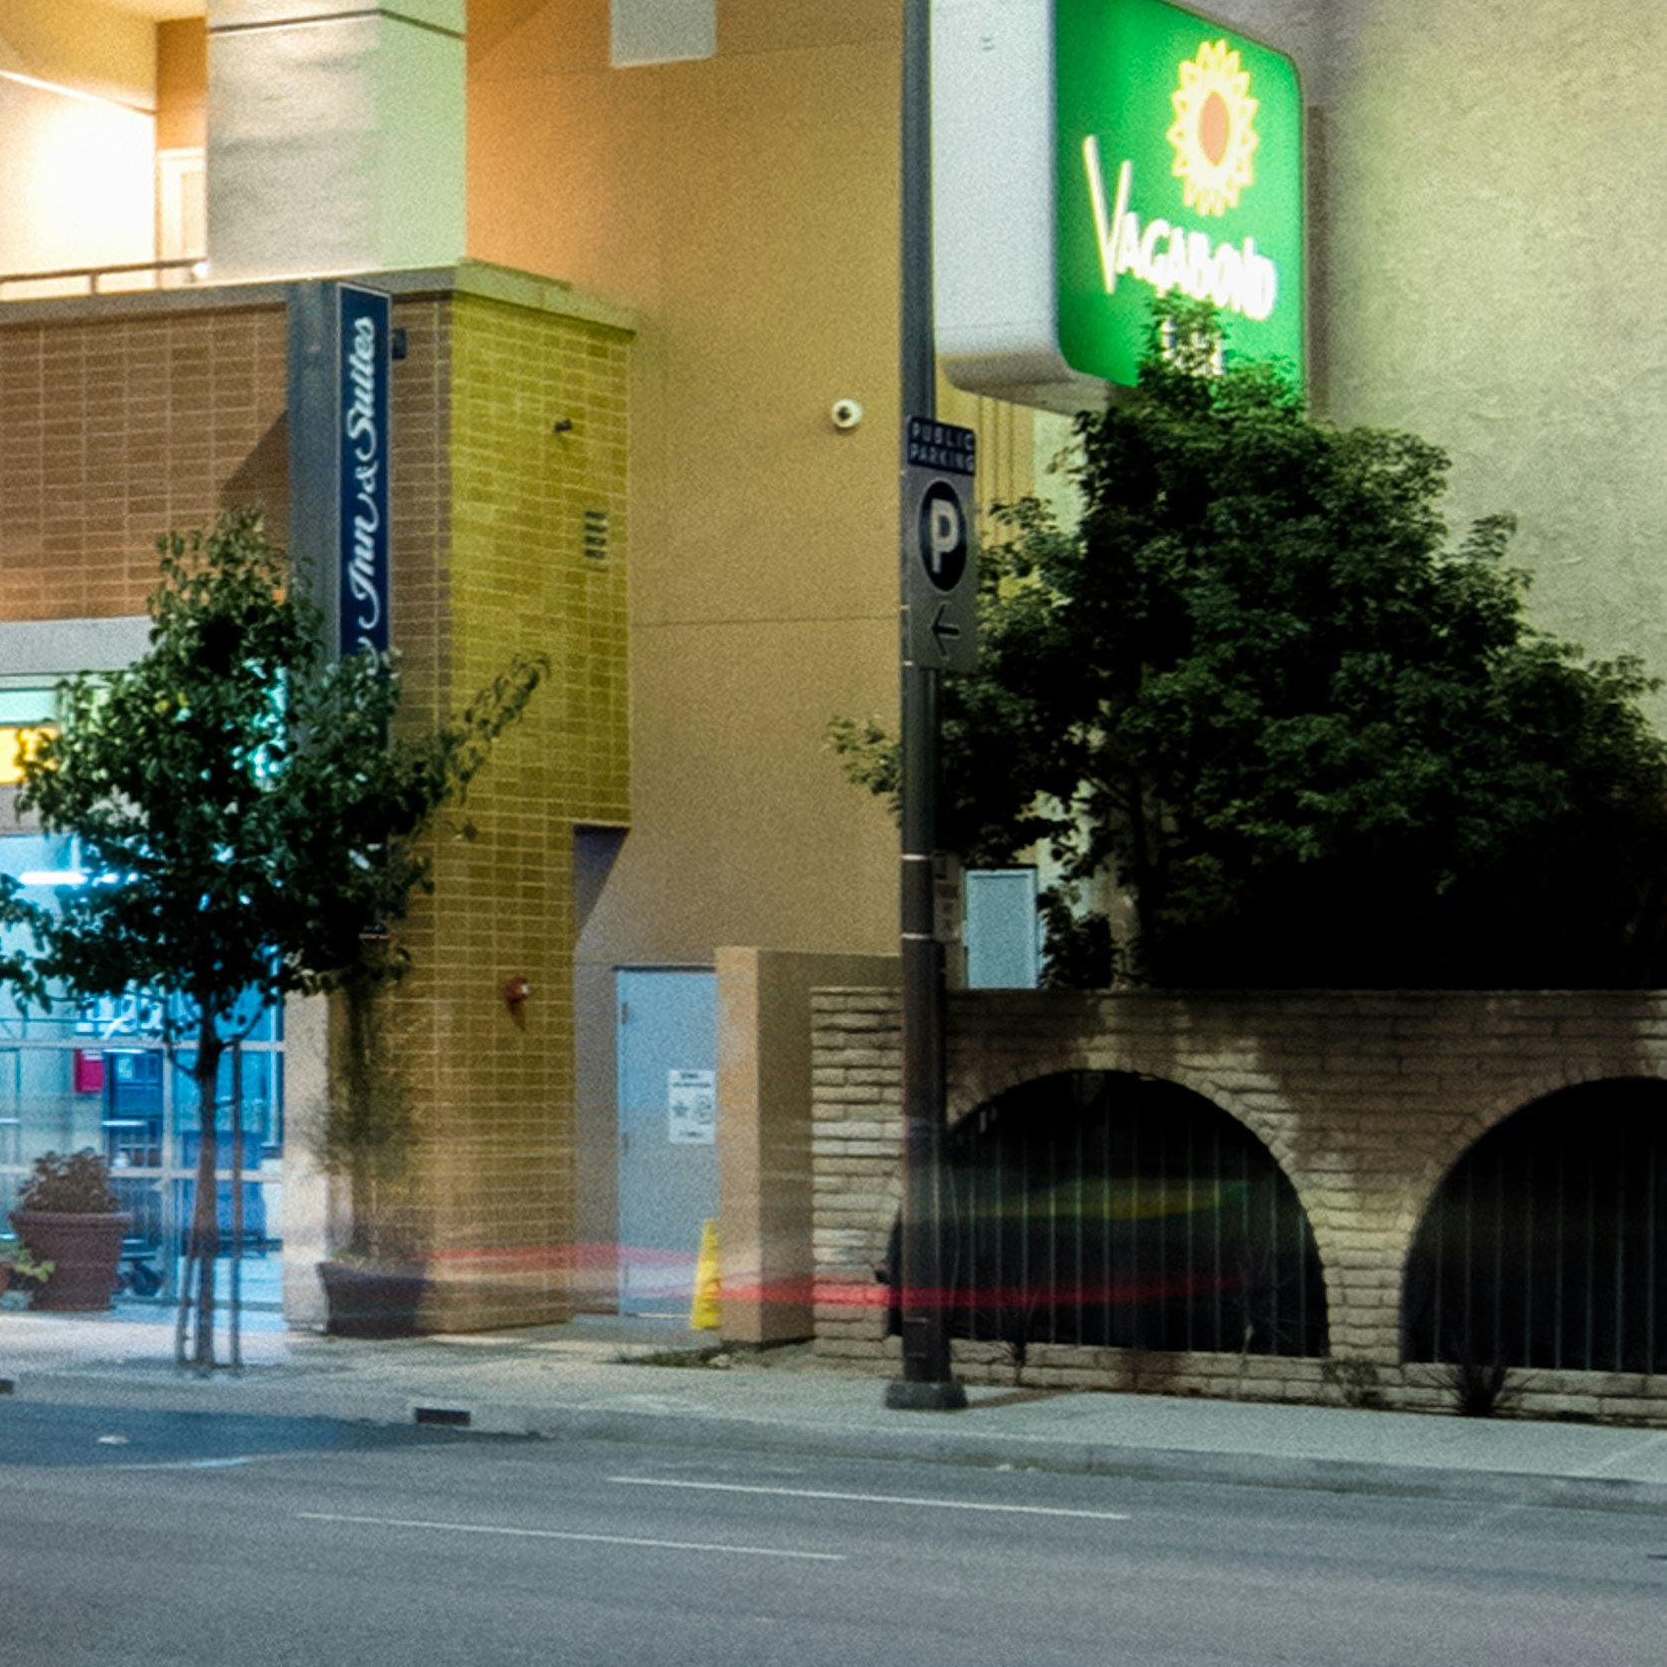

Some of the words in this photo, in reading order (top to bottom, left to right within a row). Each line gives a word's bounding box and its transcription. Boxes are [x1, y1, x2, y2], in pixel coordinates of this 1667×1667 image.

[346, 316, 378, 461] Suites
[910, 442, 975, 473] PARKING
[912, 422, 975, 452] PUBLIC
[354, 460, 379, 494] &
[347, 493, 380, 630] Inn
[929, 497, 960, 574] P
